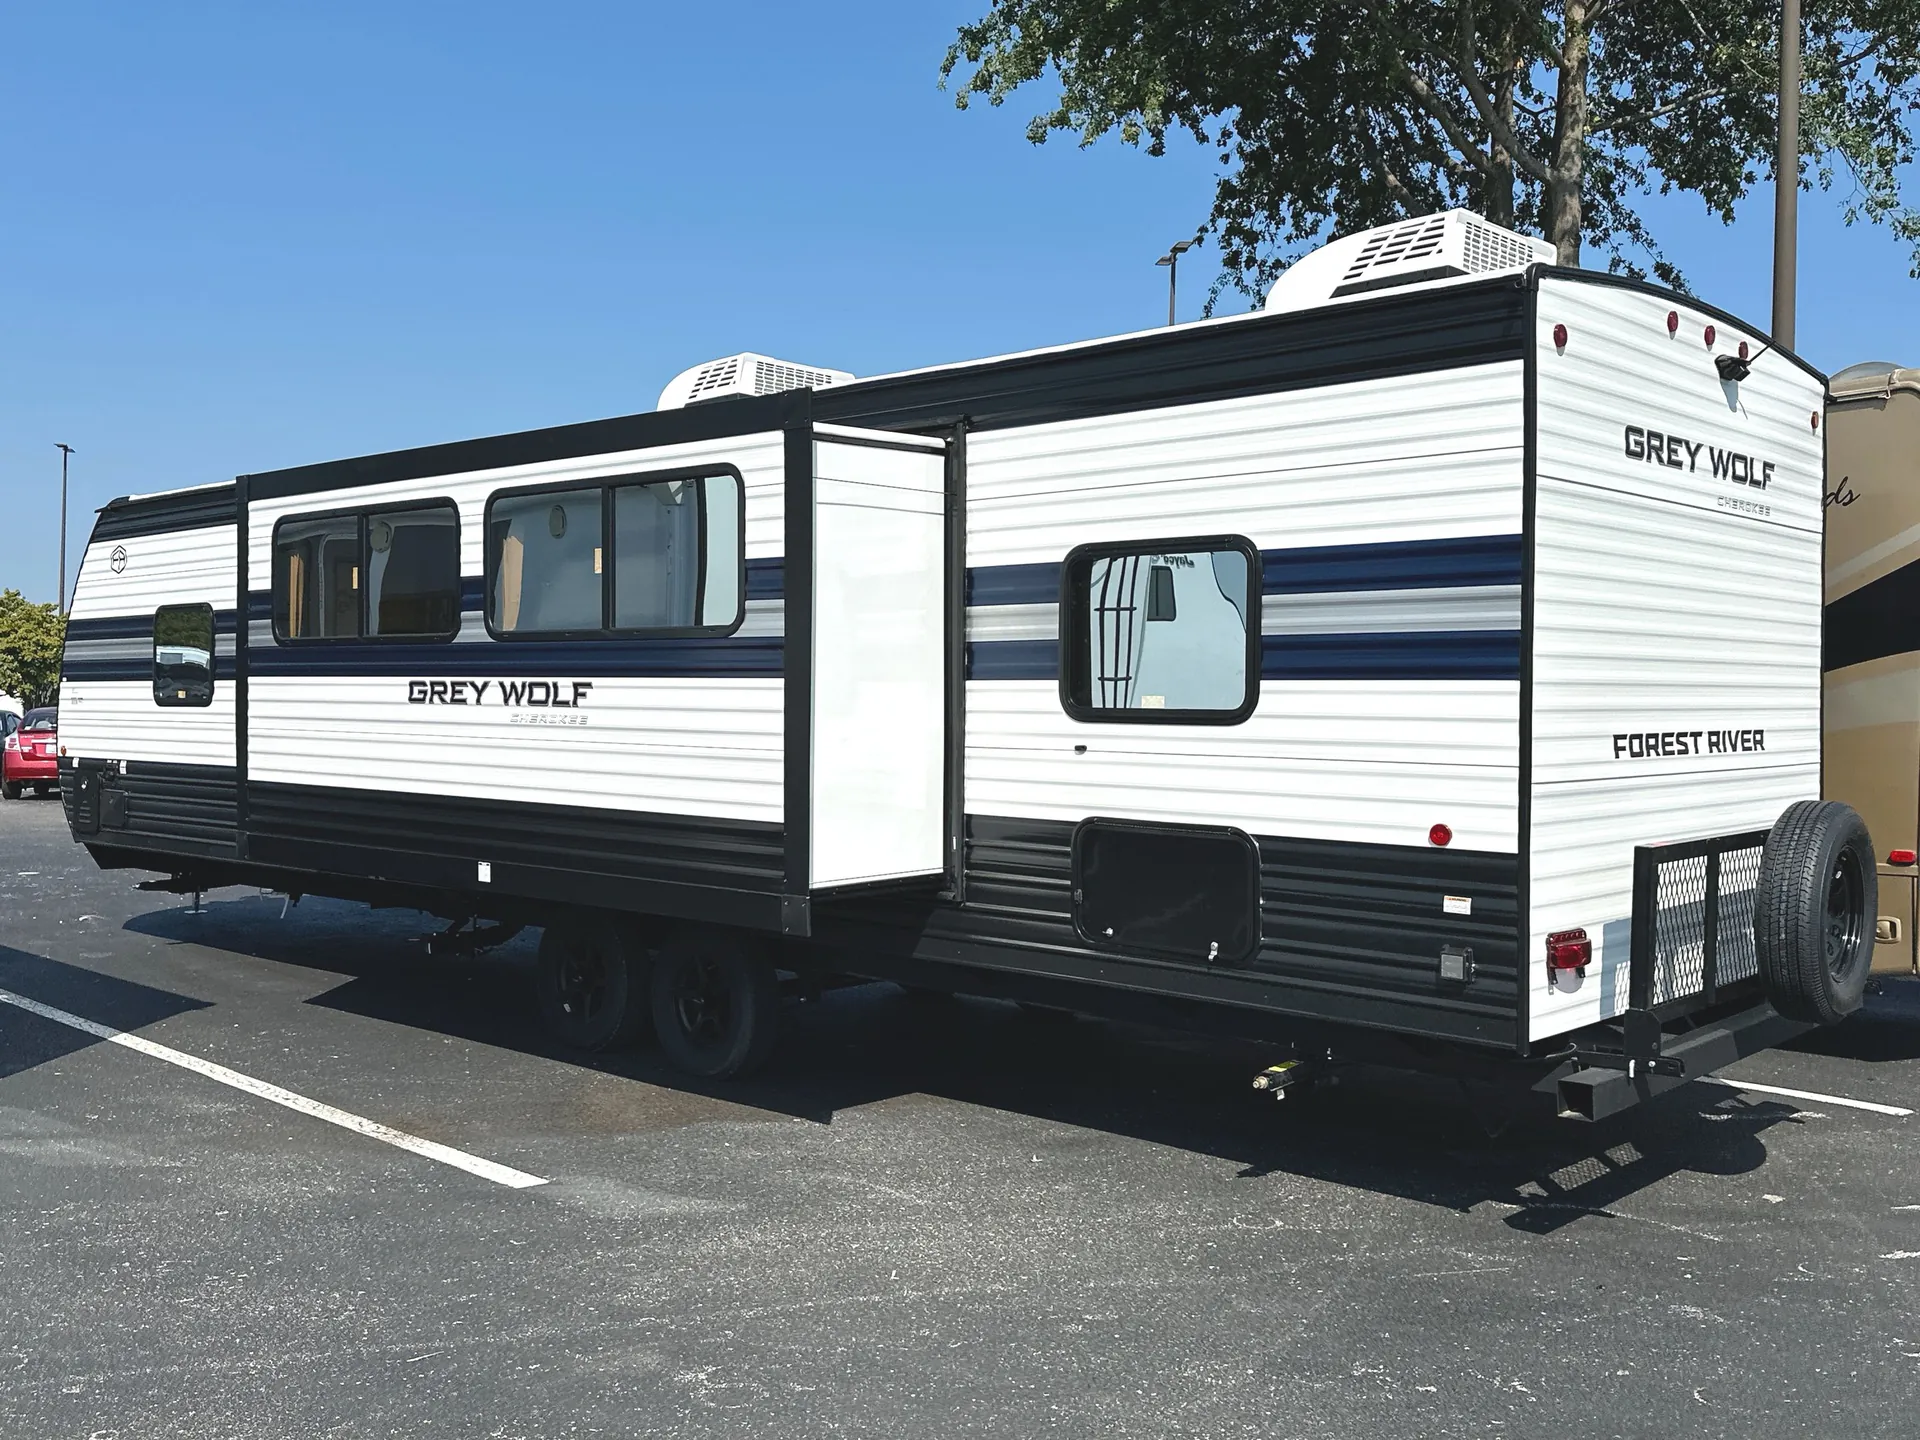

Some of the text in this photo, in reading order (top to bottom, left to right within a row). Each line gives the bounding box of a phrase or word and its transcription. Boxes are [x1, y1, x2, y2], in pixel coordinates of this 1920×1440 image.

[1625, 424, 1776, 490] GREY WOLF
[1717, 495, 1771, 517] CHEROKEE
[408, 680, 594, 708] GREY WOLF
[510, 713, 589, 725] CHEROKEE
[1612, 729, 1766, 759] FOREST RIVER
